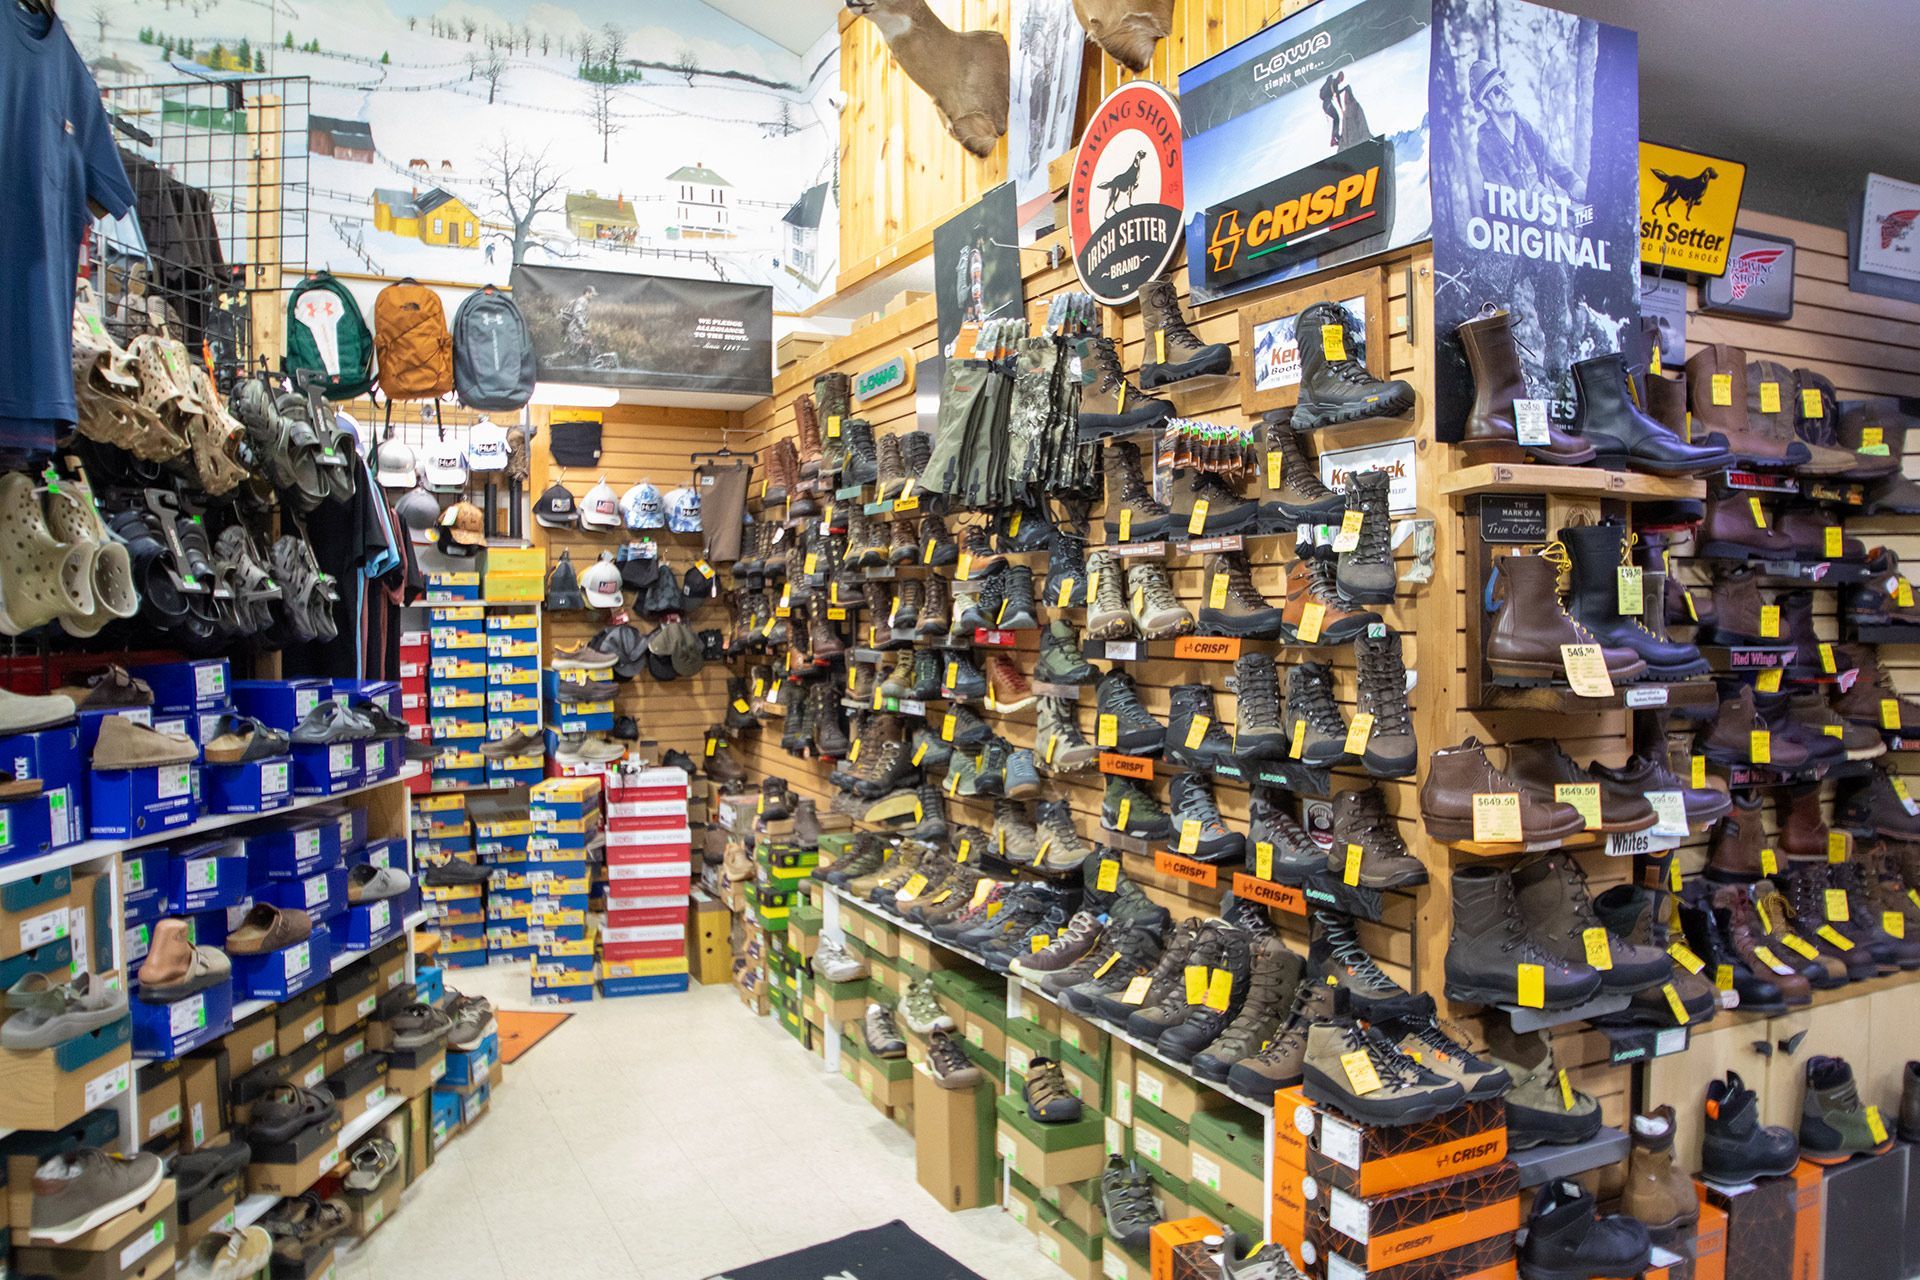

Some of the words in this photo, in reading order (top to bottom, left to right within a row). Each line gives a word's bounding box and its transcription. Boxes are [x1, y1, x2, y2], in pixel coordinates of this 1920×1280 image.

[1254, 31, 1331, 80] LOWA
[1264, 72, 1292, 91] simply
[1076, 160, 1090, 214] RED
[1089, 101, 1131, 151] WING
[1135, 100, 1179, 169] SHOES
[1247, 166, 1380, 248] CRISPI
[1483, 181, 1574, 228] TRUST
[1574, 206, 1593, 224] THE
[1640, 216, 1663, 240] sh
[1665, 222, 1724, 251] Setter
[1087, 229, 1116, 276] IRISH
[1119, 217, 1167, 246] SETTER
[1466, 217, 1611, 271] ORIGINAL
[1688, 251, 1720, 264] SHOES
[1110, 255, 1140, 280] BRAND
[1735, 273, 1766, 286] SHOES
[1488, 522, 1509, 534] True
[1194, 643, 1229, 654] CRISPI
[1115, 760, 1144, 773] CRISPI
[1559, 787, 1596, 797] $649.50
[1477, 797, 1516, 807] $649.50
[1612, 834, 1648, 853] Whites
[1173, 863, 1208, 879] CRISPI
[1255, 886, 1294, 905] CRISPI
[1452, 1141, 1498, 1164] CRISPI
[1395, 1234, 1434, 1253] CRISPI
